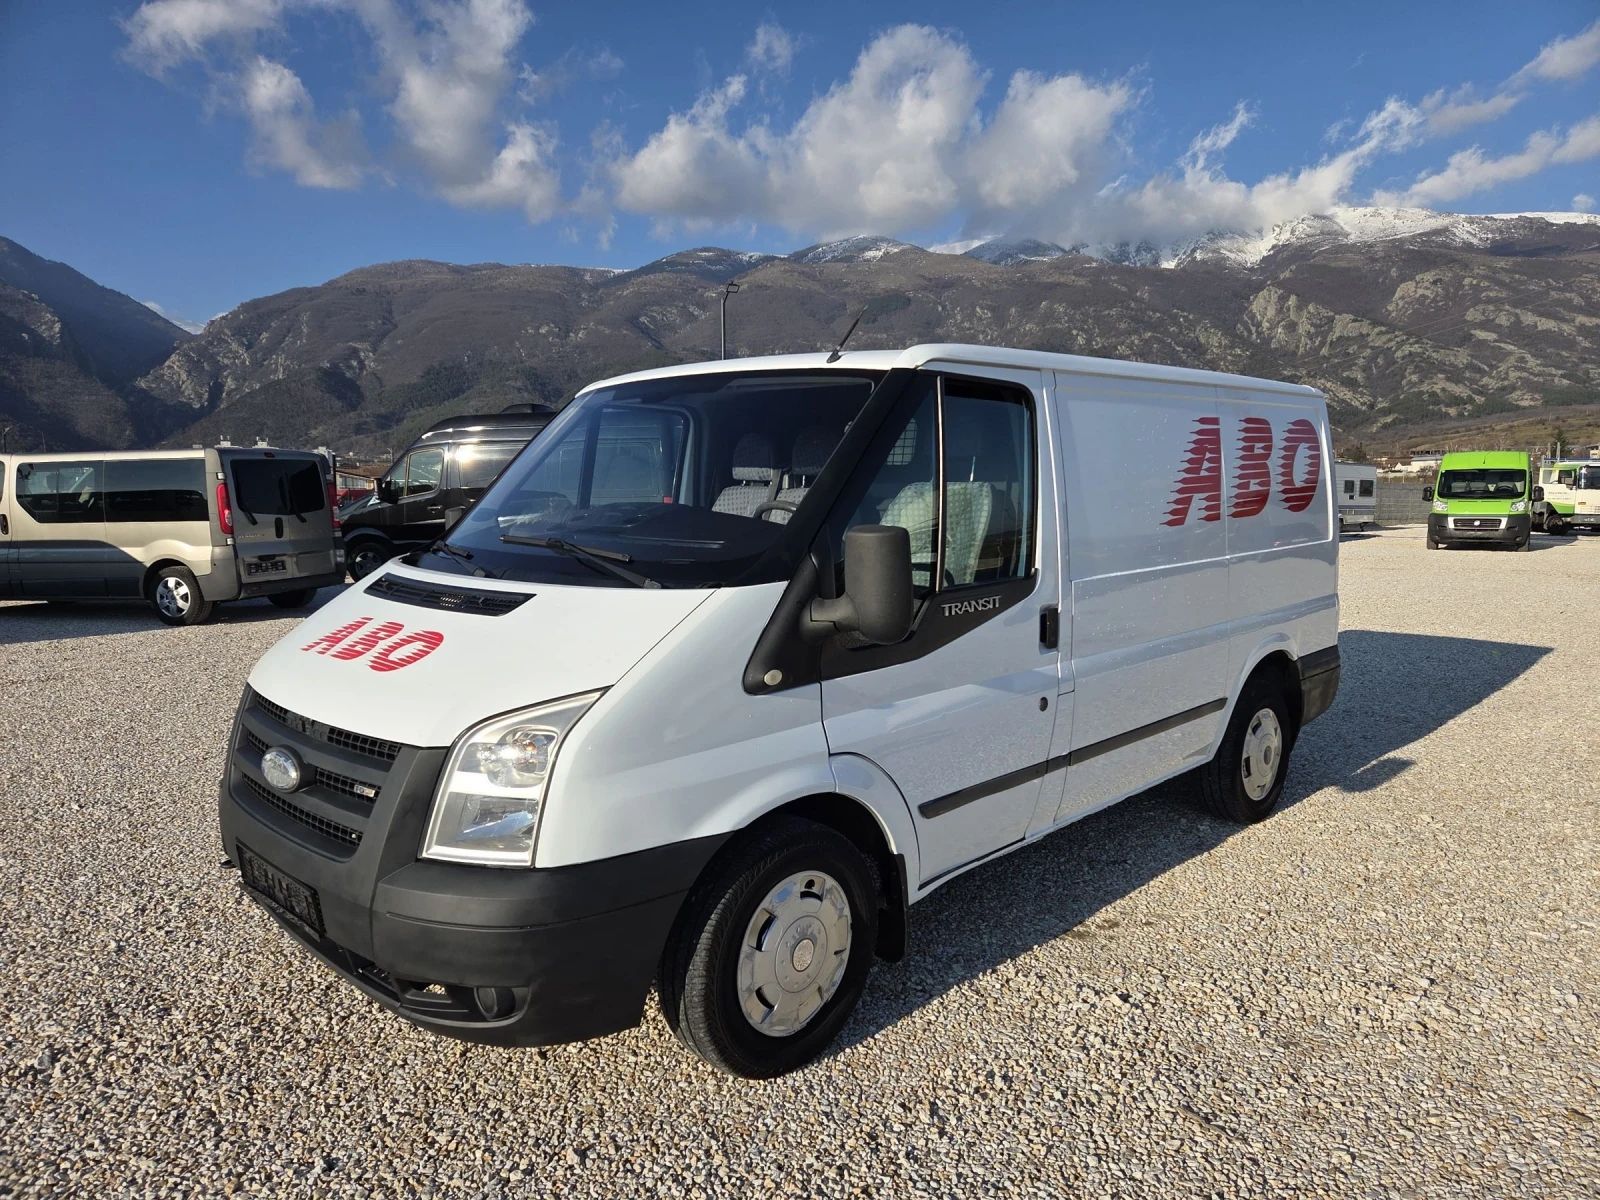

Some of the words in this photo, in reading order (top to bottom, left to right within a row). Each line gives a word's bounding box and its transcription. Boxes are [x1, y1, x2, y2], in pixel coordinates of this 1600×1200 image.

[1160, 416, 1321, 527] ABO
[941, 596, 1001, 617] TRANSIT
[300, 616, 445, 672] ABO
